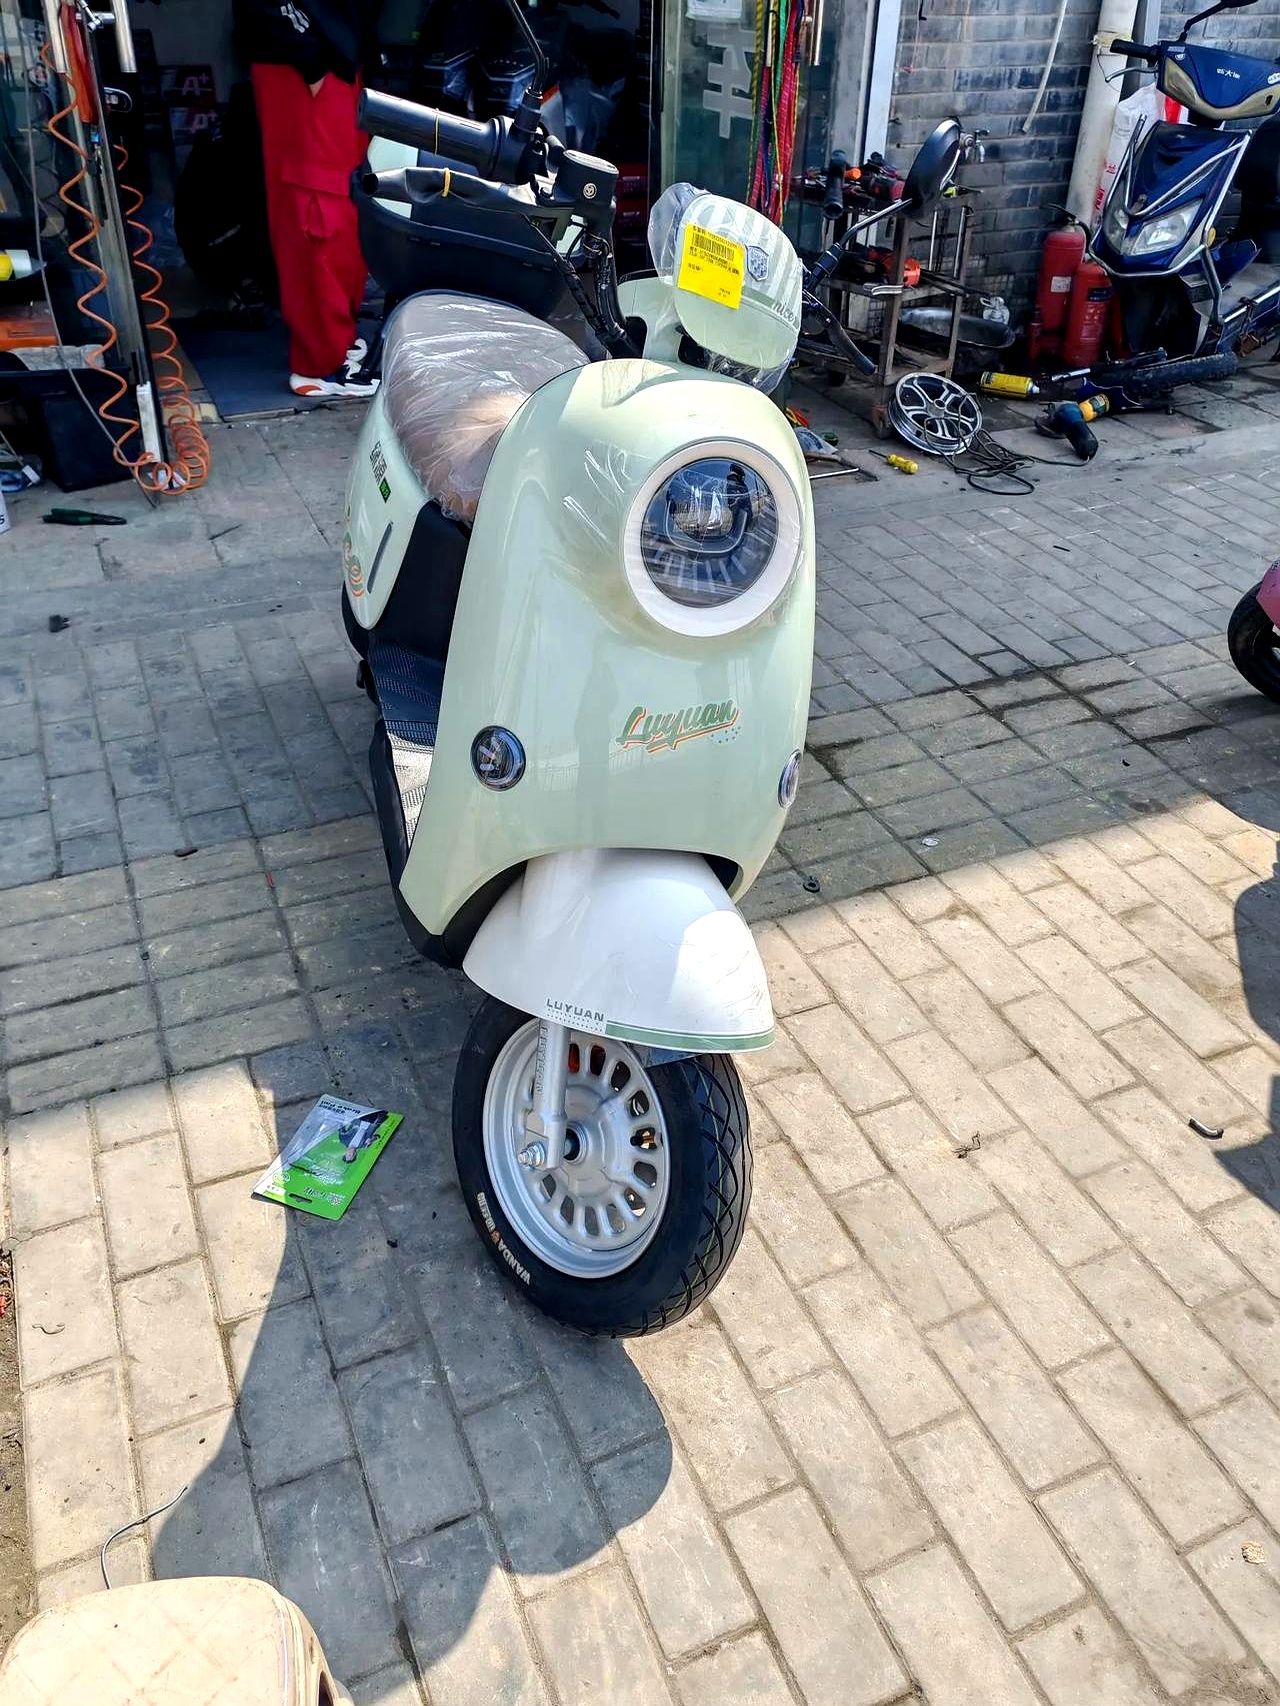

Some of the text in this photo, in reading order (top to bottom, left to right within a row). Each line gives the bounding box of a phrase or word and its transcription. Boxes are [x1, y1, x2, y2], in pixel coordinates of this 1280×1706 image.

[615, 699, 740, 753] Luyuan
[546, 998, 605, 1023] LUYUAN
[497, 1238, 531, 1286] WANDA
